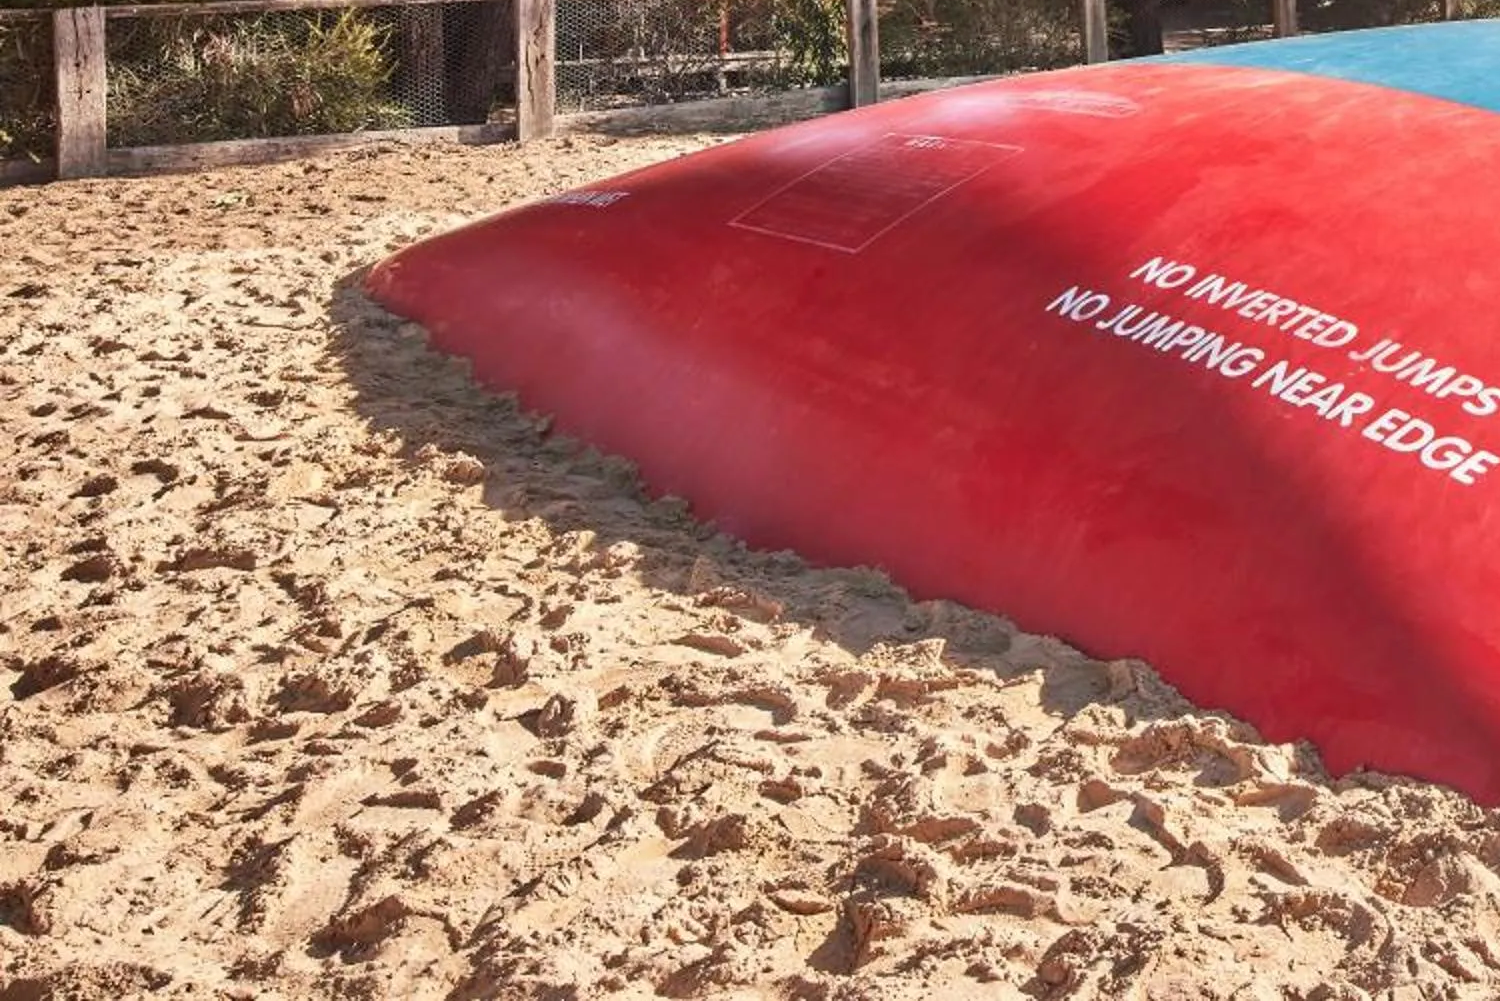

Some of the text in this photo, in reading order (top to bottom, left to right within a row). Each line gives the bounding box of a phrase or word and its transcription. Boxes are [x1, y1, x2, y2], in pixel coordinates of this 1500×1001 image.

[1045, 286, 1110, 322] NO
[1095, 304, 1266, 378] JUMPING
[1251, 359, 1376, 428] NEAR
[1129, 256, 1197, 290] NO
[1184, 273, 1359, 349] INVERTED
